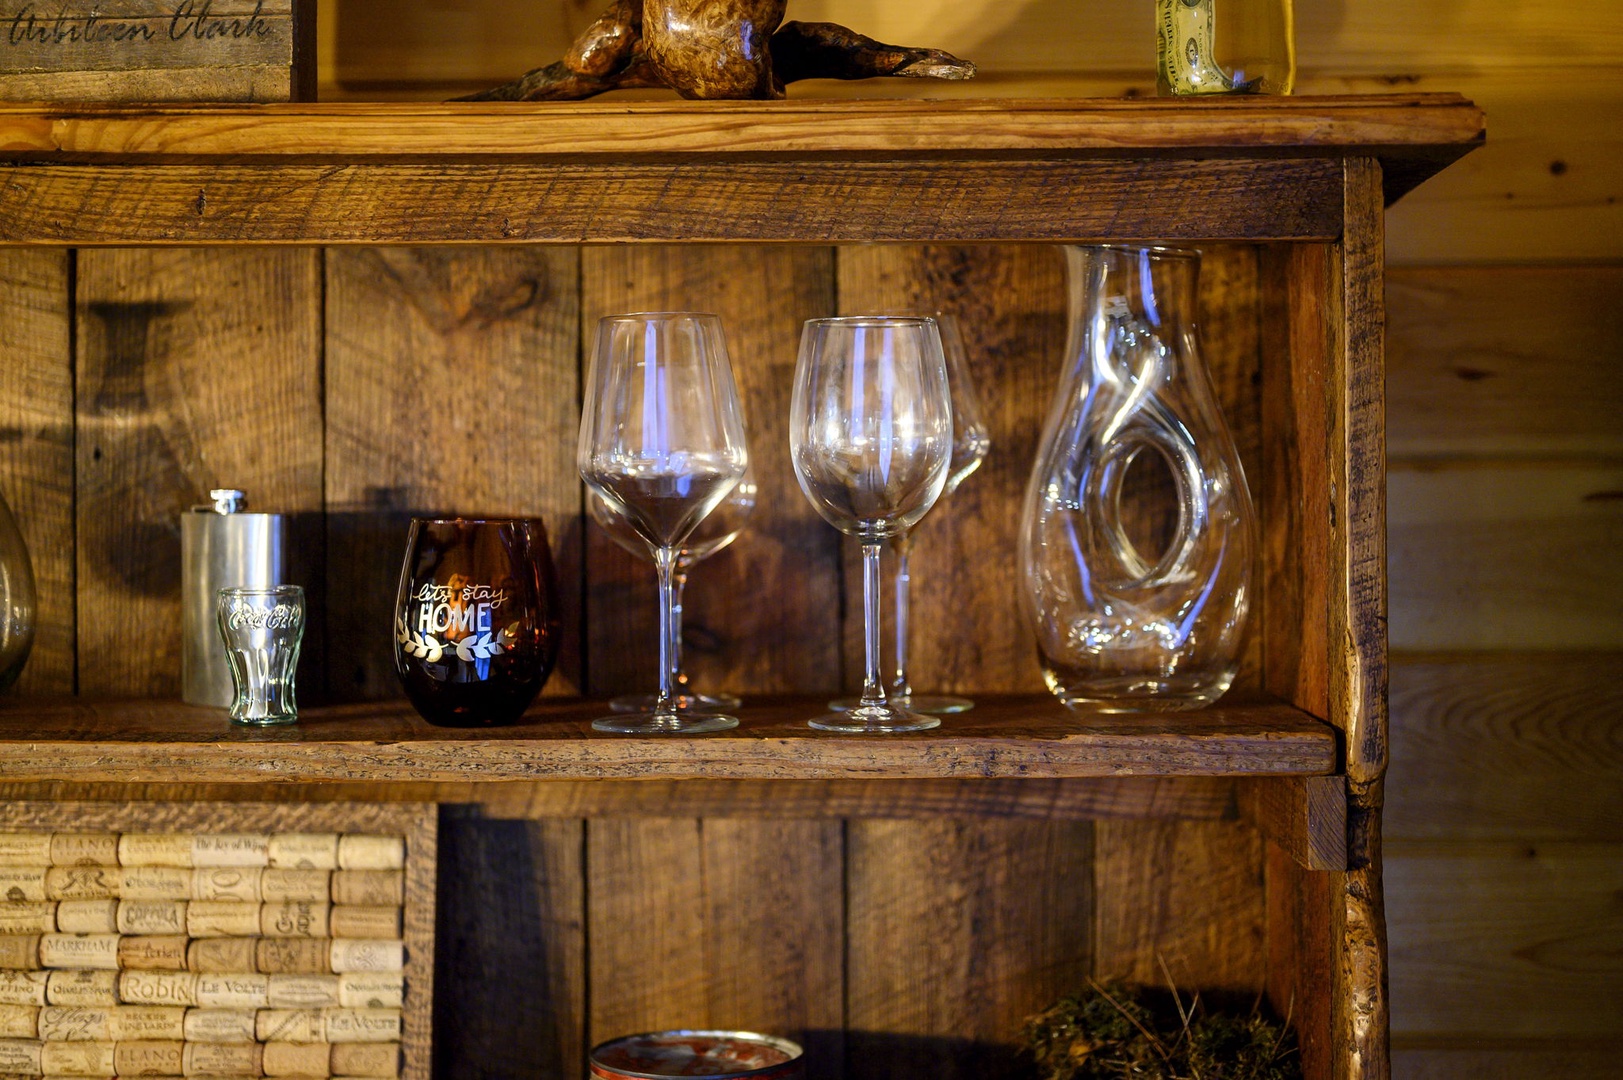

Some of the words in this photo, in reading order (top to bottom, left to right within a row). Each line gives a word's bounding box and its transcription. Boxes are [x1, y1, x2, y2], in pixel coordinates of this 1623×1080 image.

[168, 0, 270, 41] Clark
[461, 583, 508, 609] stay
[418, 602, 491, 634] HOME
[47, 938, 113, 953] MARKHAM
